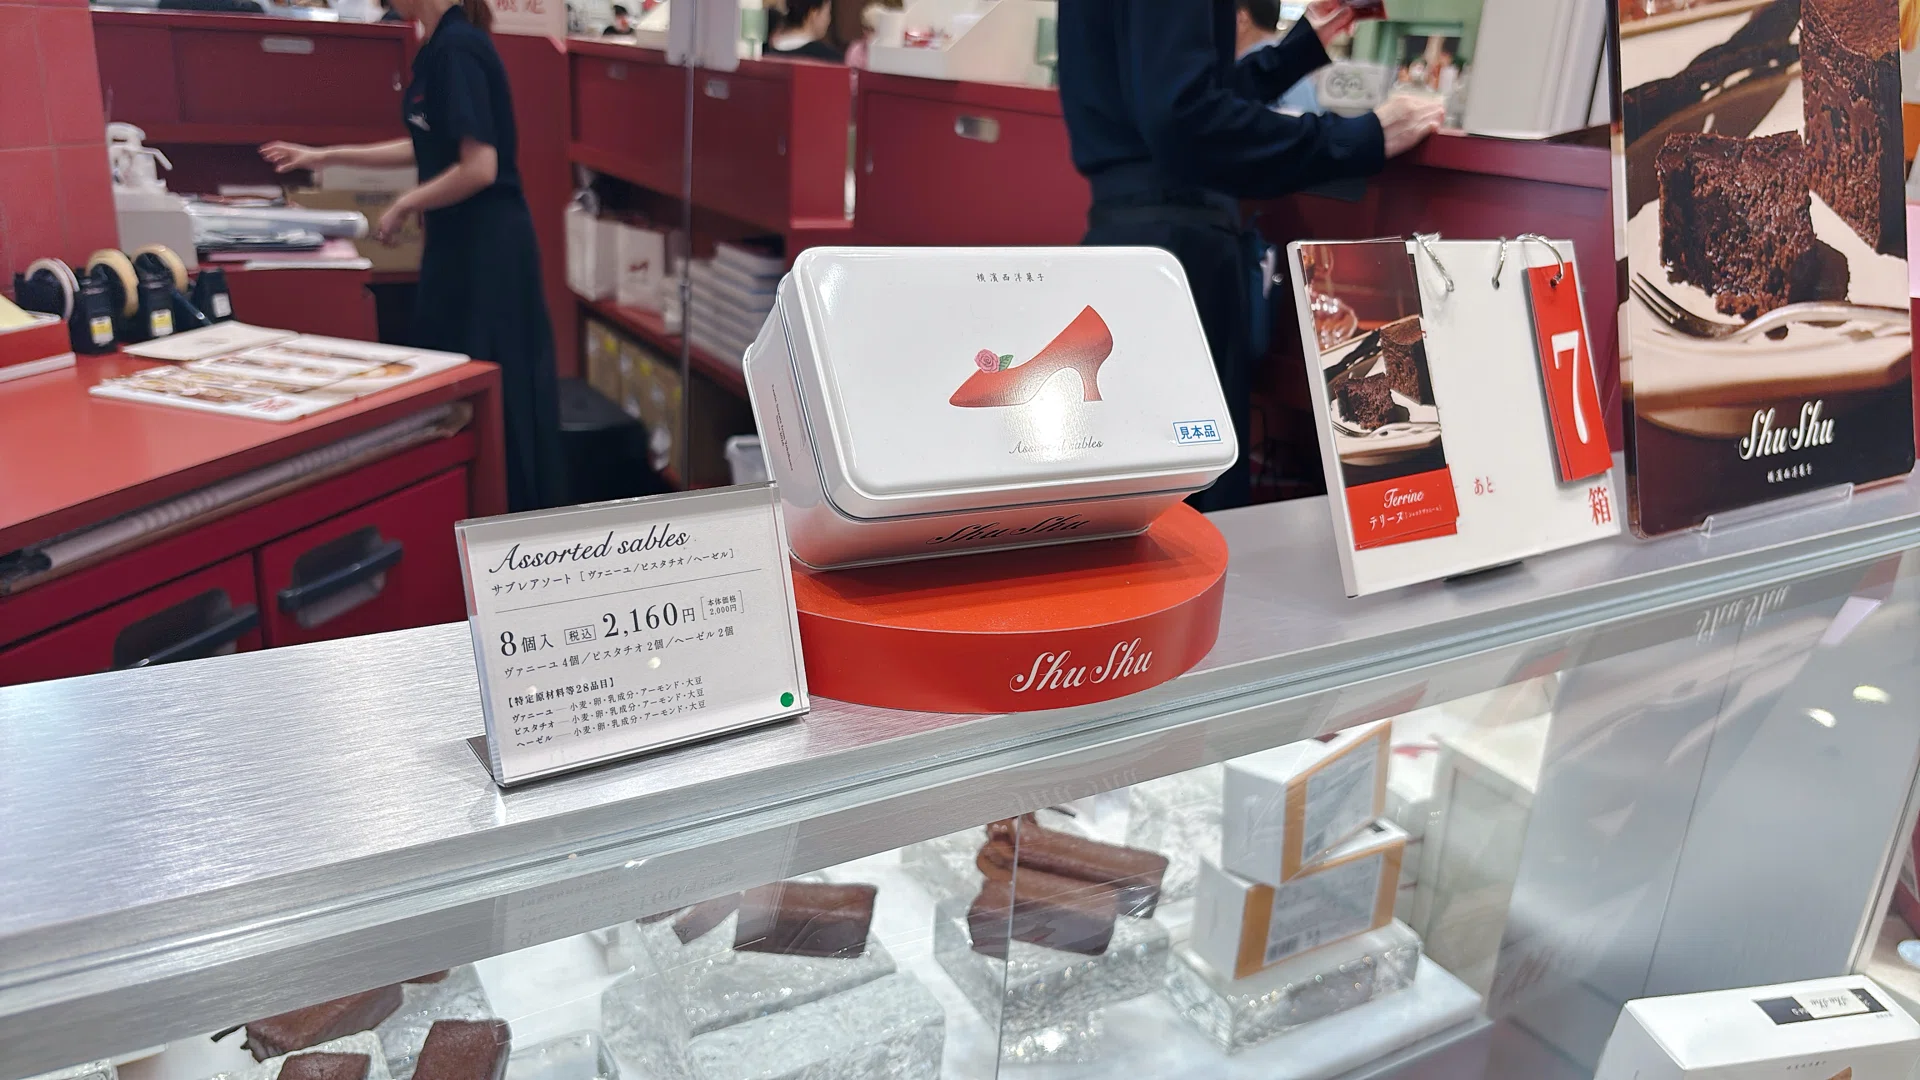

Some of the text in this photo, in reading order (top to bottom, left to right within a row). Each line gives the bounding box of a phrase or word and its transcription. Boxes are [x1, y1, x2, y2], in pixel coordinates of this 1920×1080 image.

[1550, 329, 1591, 445] 7
[1180, 424, 1217, 440] 見本品
[1473, 476, 1495, 495] あと
[1383, 487, 1425, 509] Terrine
[1588, 485, 1612, 526] 箱
[488, 523, 691, 574] Assorted sables
[491, 573, 572, 597] サブレアソート
[707, 595, 737, 607] 本体価格
[500, 602, 696, 657] 8個入 税込 2,160円
